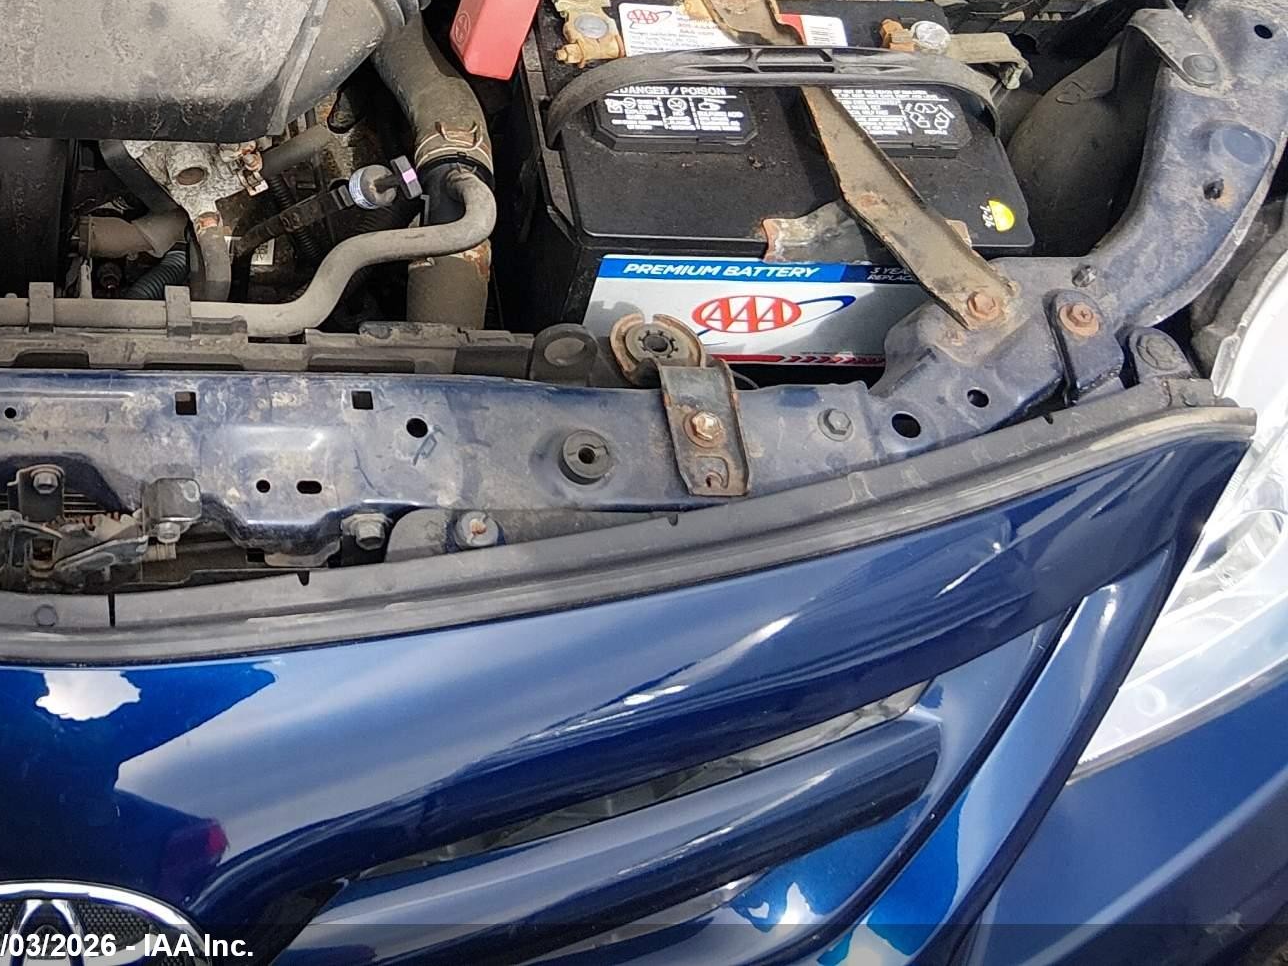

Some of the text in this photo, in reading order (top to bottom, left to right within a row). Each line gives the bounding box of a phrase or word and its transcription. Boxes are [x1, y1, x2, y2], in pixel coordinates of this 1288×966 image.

[629, 9, 659, 24] AAA
[680, 87, 727, 95] POISON
[623, 263, 821, 278] PREMIUM BATTERY
[697, 296, 792, 333] AAA
